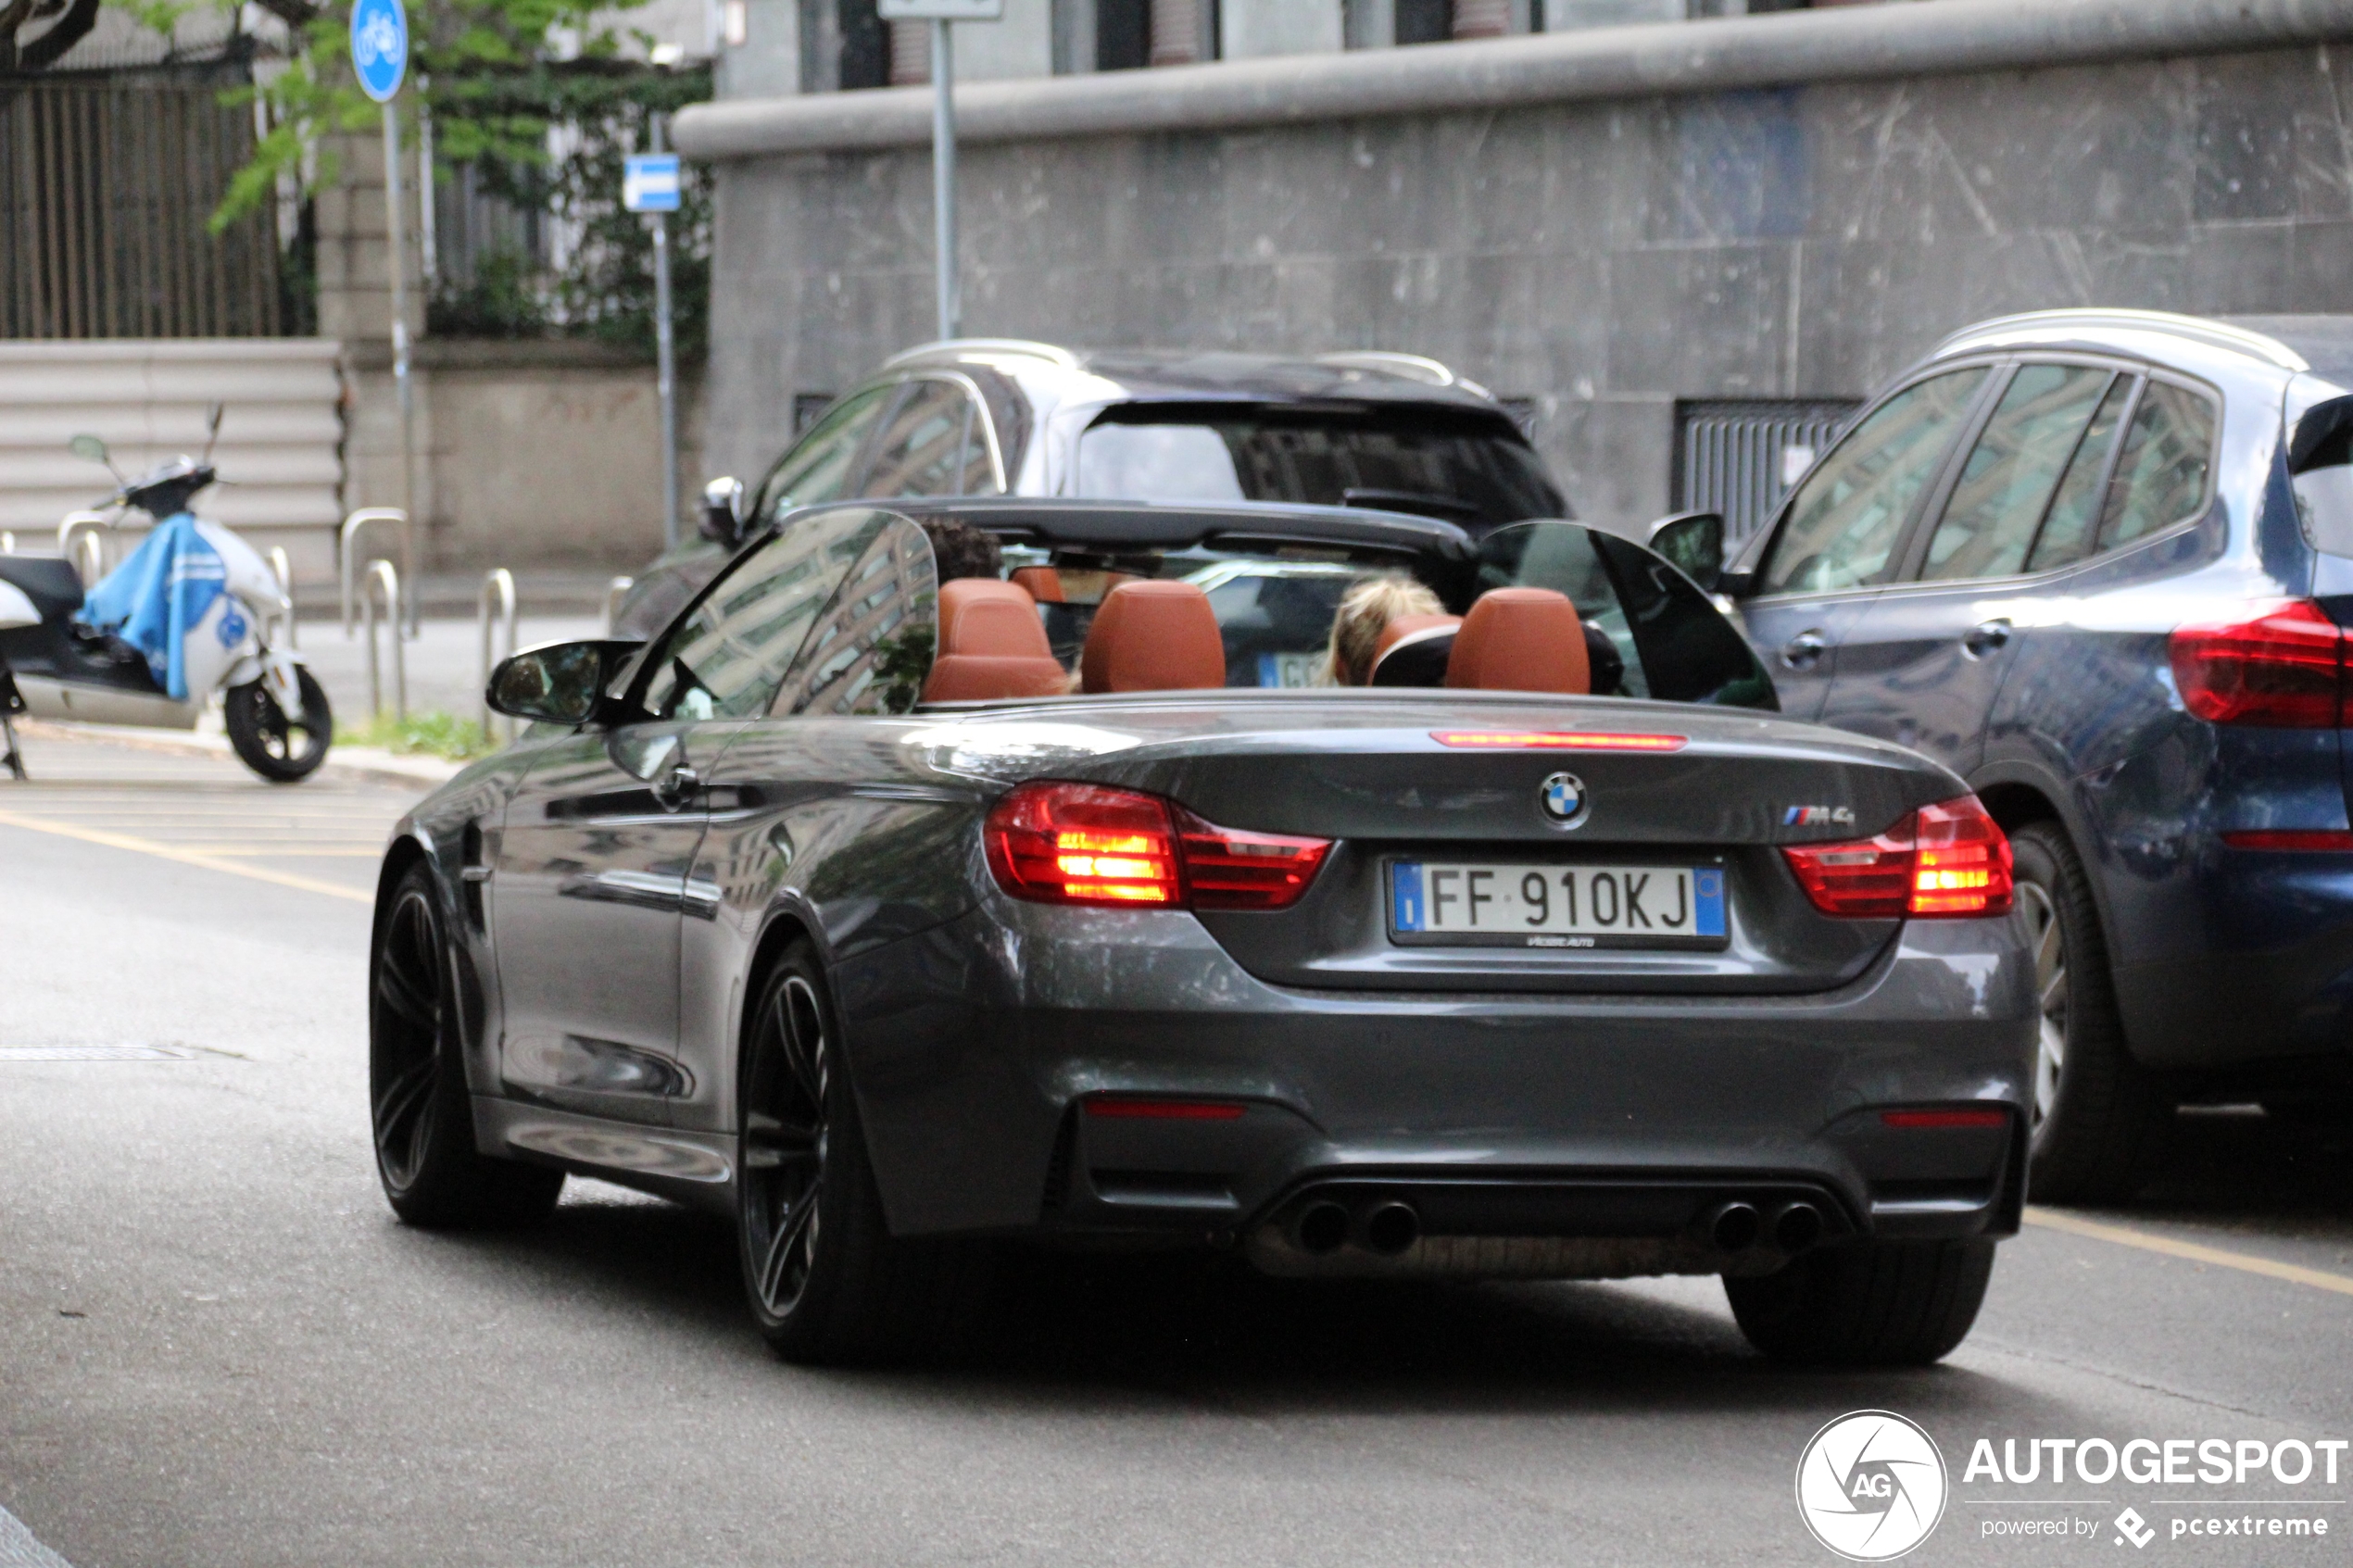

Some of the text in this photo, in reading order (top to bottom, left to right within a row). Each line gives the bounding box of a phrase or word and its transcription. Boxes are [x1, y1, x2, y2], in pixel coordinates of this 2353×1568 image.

[1804, 806, 1856, 825] M4
[1430, 870, 1688, 929] FF 910KJ
